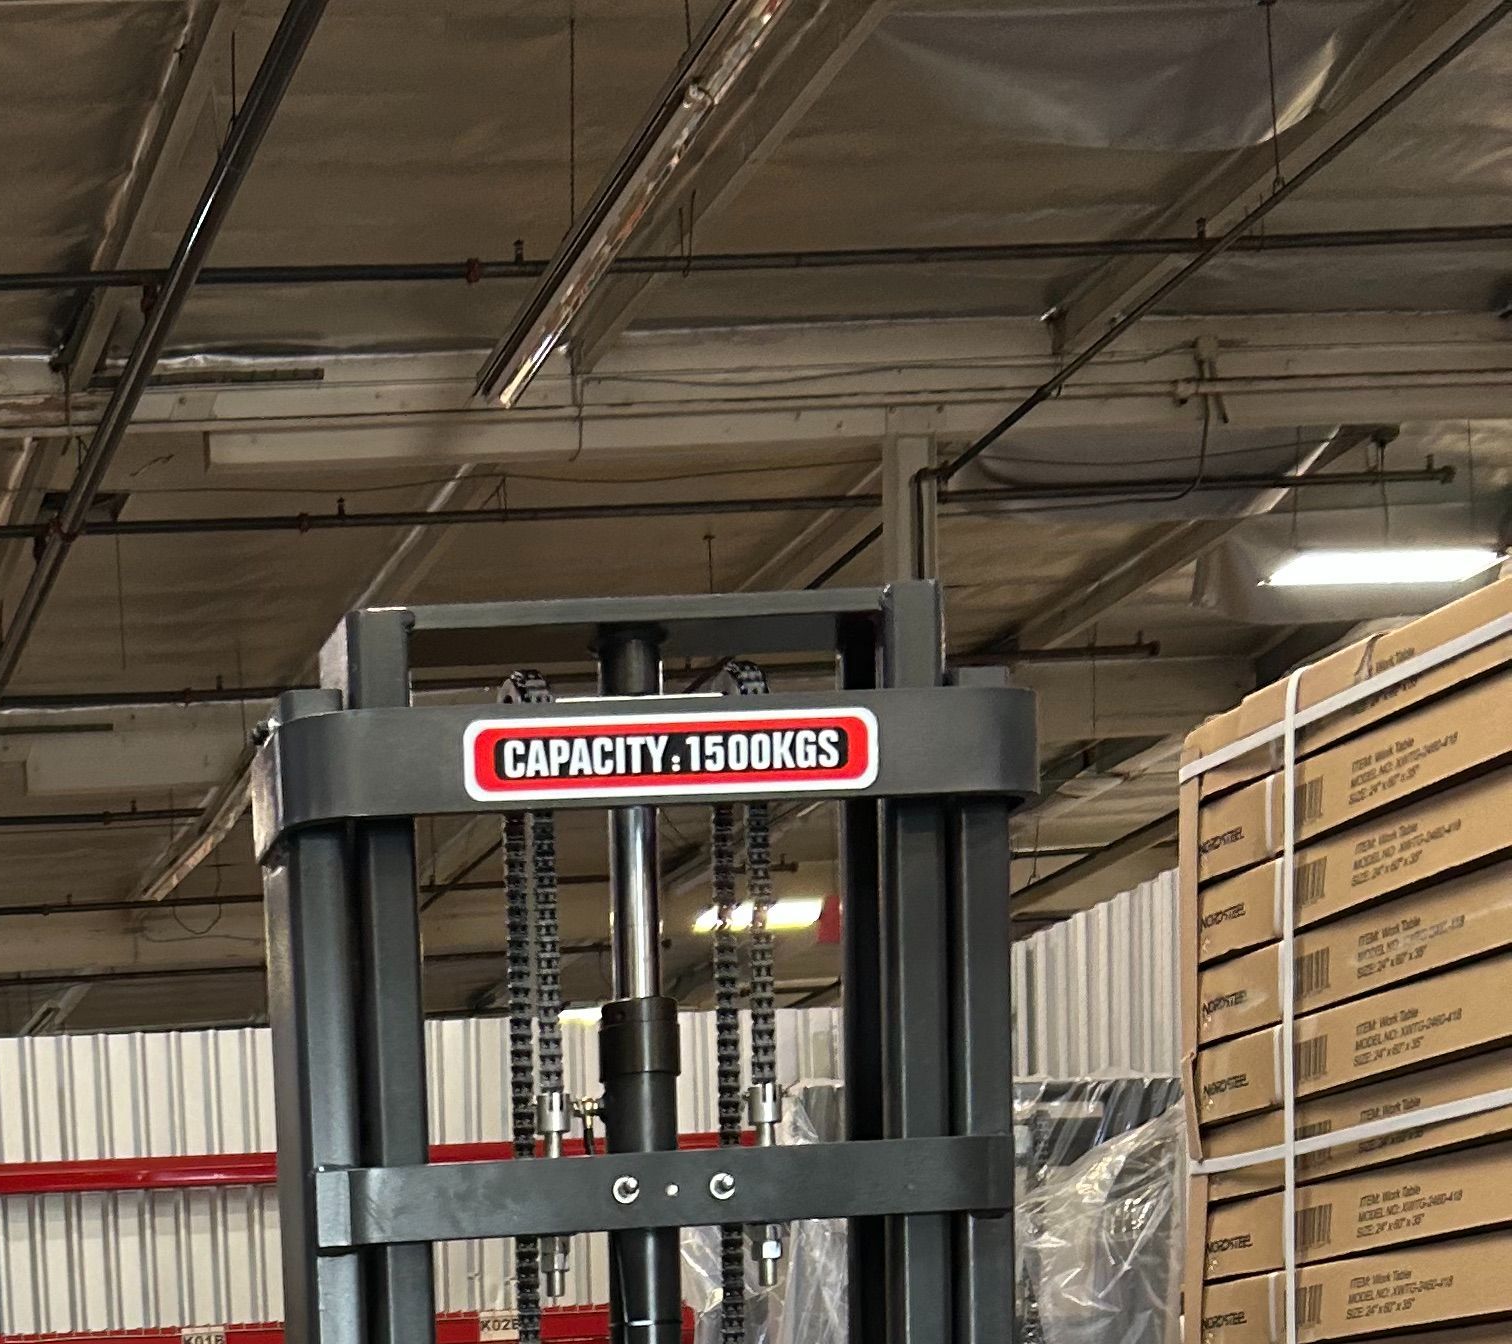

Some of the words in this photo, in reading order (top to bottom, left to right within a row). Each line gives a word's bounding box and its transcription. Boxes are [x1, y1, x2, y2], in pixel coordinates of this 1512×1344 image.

[1379, 1014, 1396, 1028] Work
[1399, 1008, 1418, 1023] Table
[1374, 1273, 1390, 1285] Work
[1393, 1270, 1411, 1282] Table
